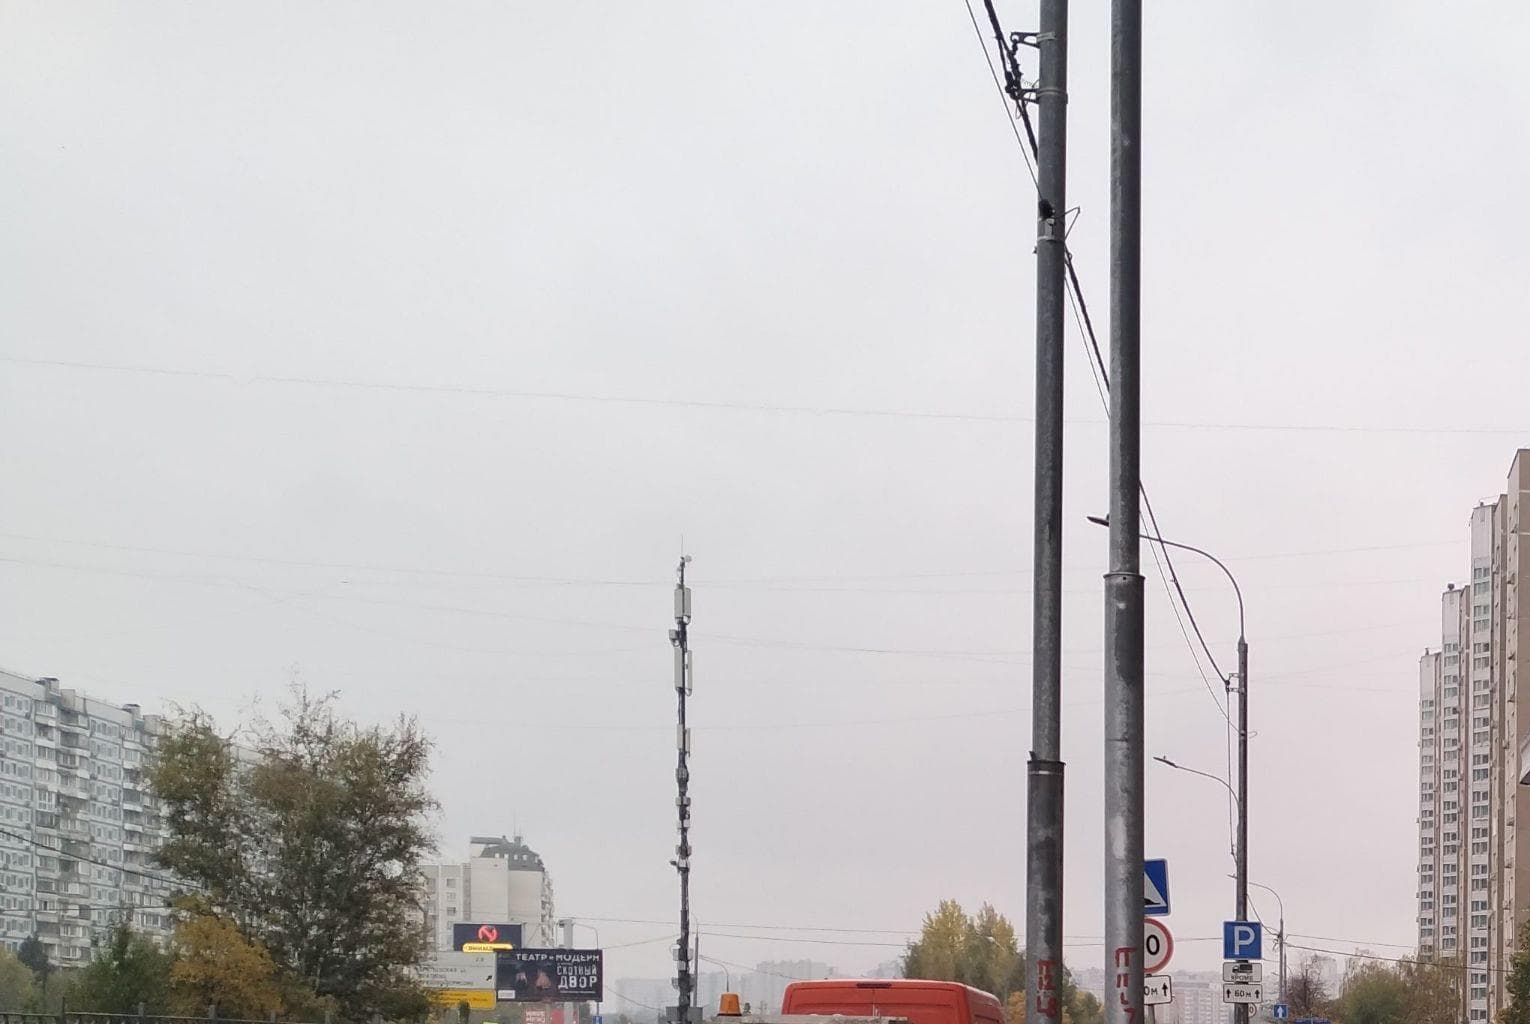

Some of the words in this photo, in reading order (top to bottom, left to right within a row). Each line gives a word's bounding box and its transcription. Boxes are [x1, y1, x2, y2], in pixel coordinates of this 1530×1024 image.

[1146, 934, 1160, 955] 0
[516, 953, 547, 961] ТЕАТР
[557, 976, 598, 989] ДВОР
